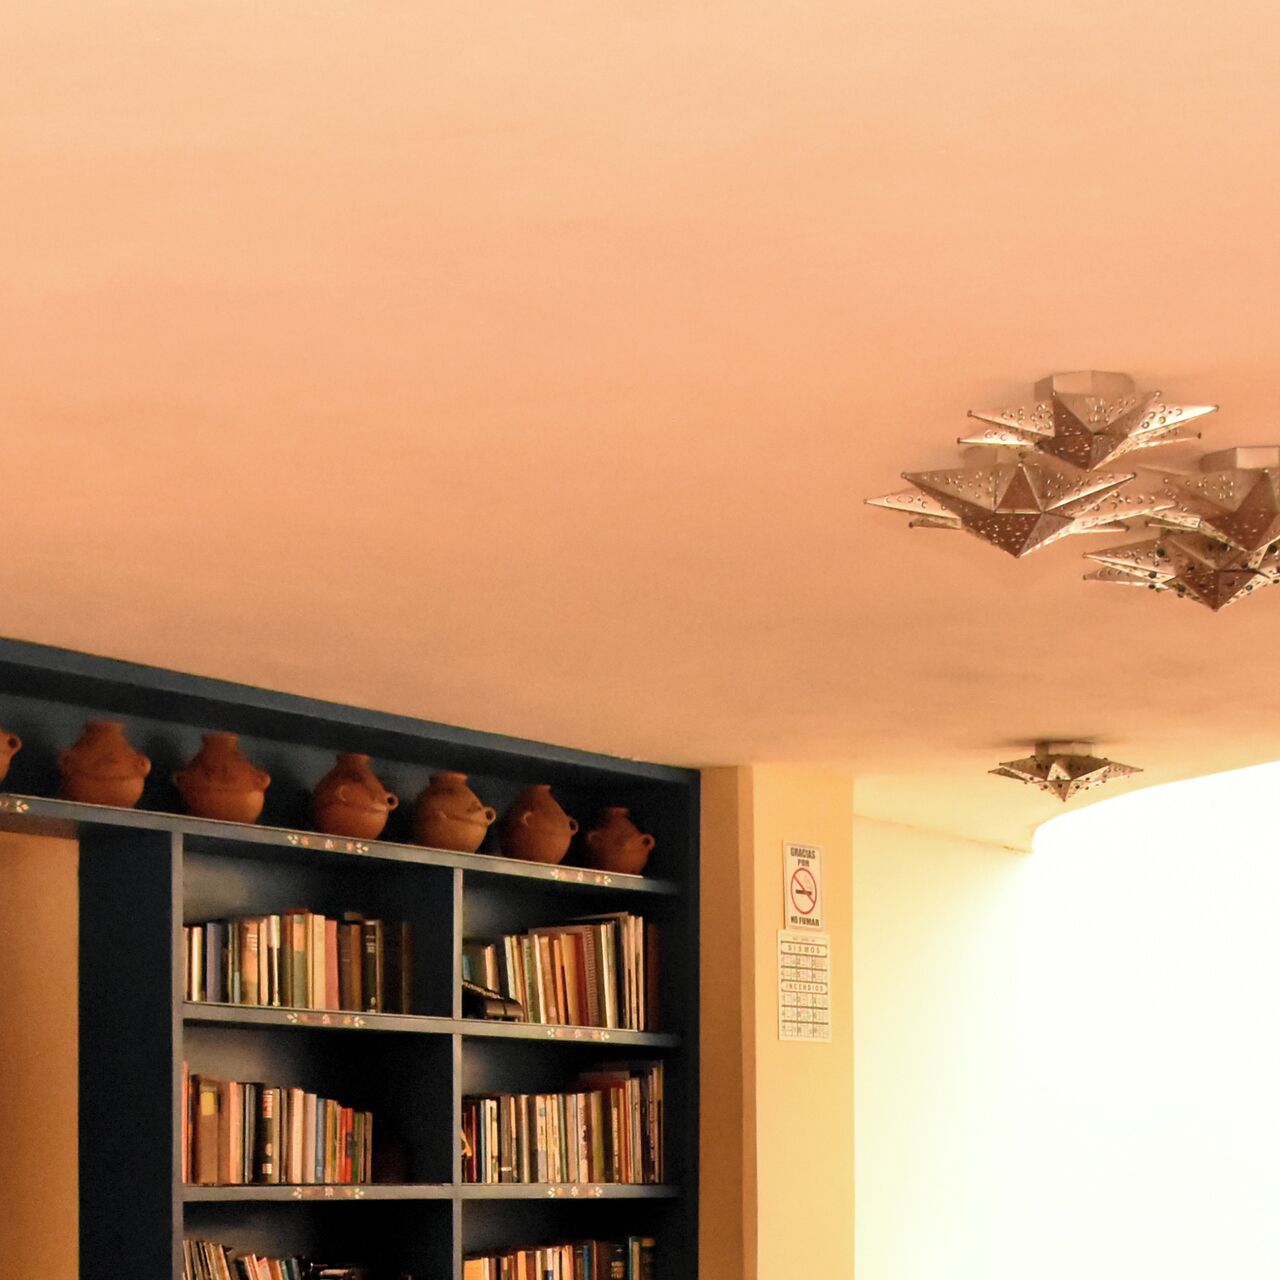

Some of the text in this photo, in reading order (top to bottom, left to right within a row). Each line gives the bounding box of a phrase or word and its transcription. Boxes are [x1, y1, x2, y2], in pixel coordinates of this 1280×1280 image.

[790, 847, 816, 859] GRACIAS
[797, 859, 810, 867] POR
[791, 916, 820, 926] NO FUMAR
[788, 945, 820, 954] SISMOS
[785, 983, 823, 991] INCENDIOS
